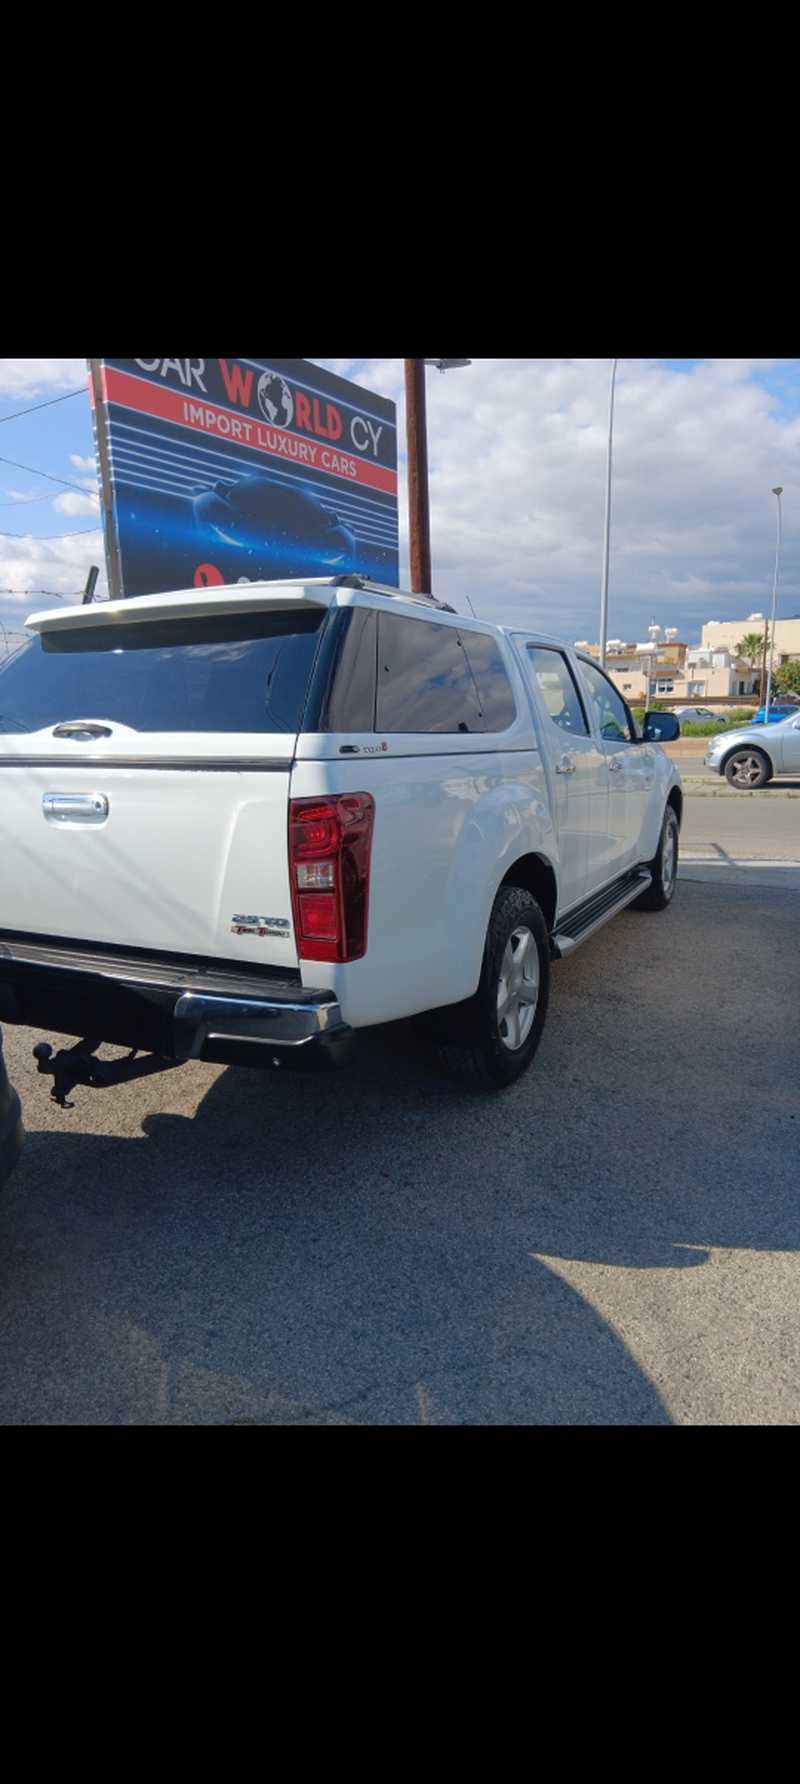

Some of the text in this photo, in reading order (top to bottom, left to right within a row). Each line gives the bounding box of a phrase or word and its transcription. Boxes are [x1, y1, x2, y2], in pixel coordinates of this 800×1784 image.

[183, 402, 358, 477] IMPORT LUXURY CARS
[350, 416, 383, 456] CY
